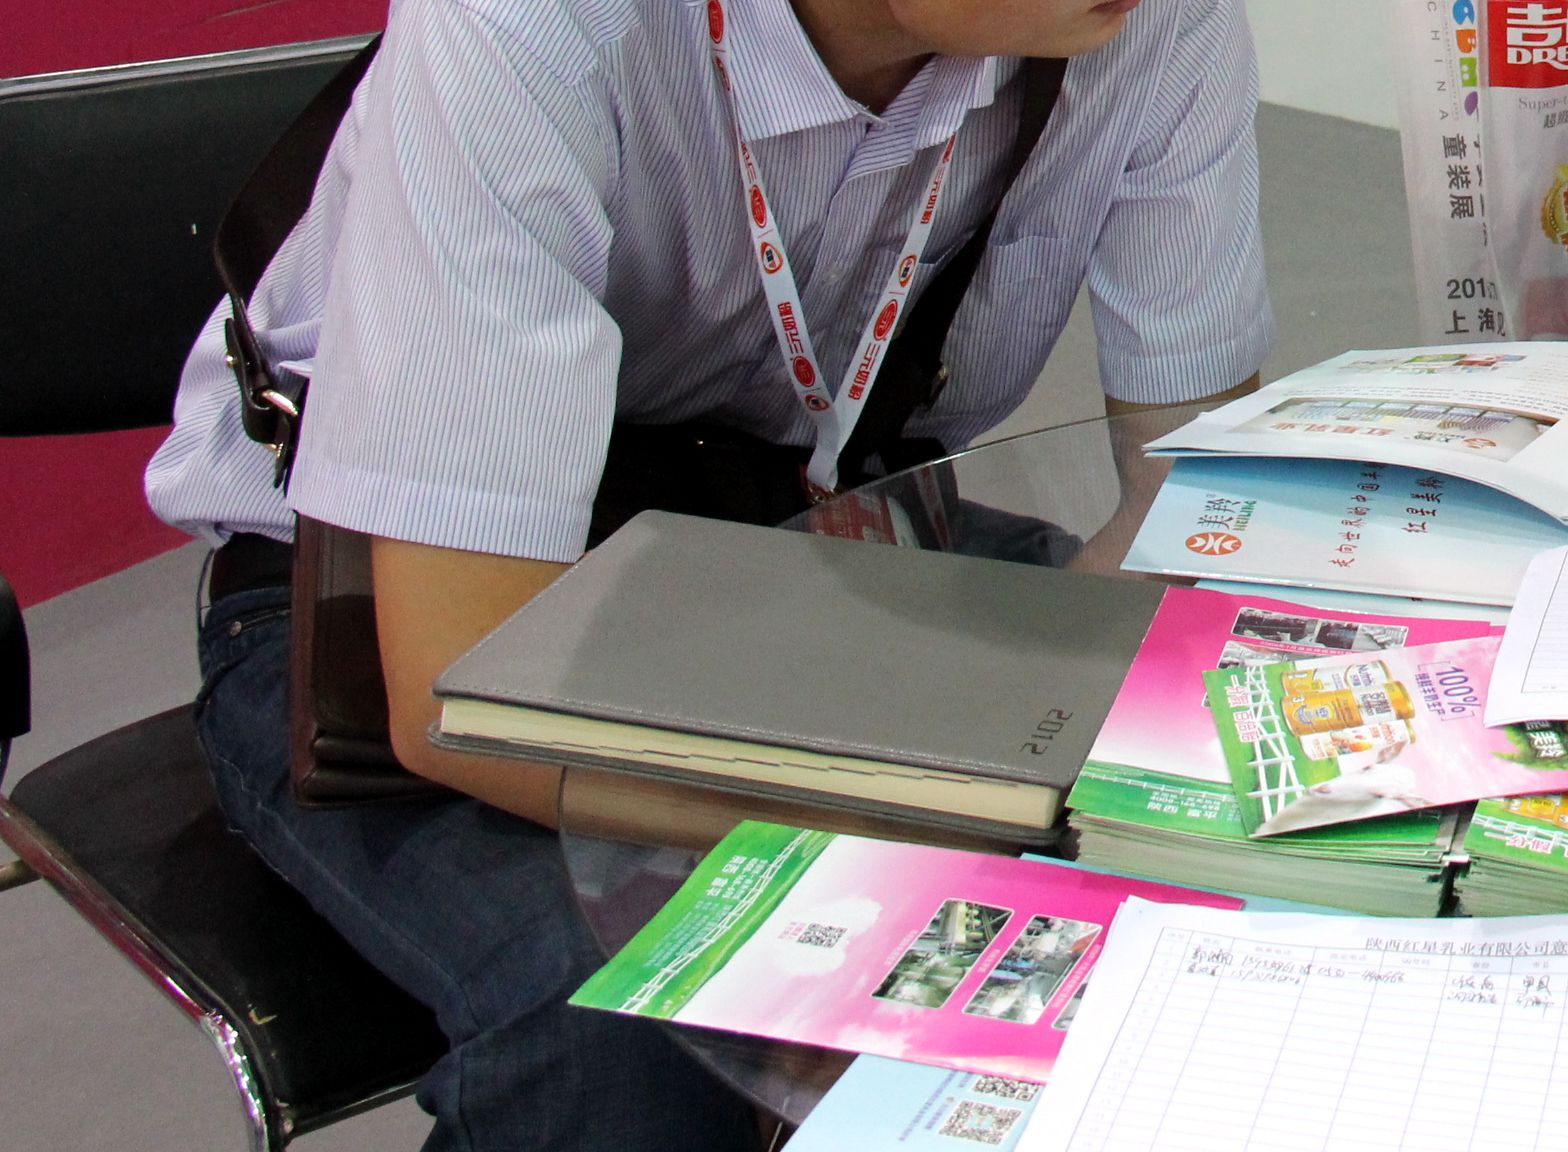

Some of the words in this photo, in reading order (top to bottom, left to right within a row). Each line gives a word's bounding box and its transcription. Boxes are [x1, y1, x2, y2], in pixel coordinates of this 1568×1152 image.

[1427, 1, 1449, 120] CHINA
[1442, 134, 1475, 220] 童装展
[848, 342, 882, 401] 三元奶粉
[1435, 666, 1482, 714] 100%
